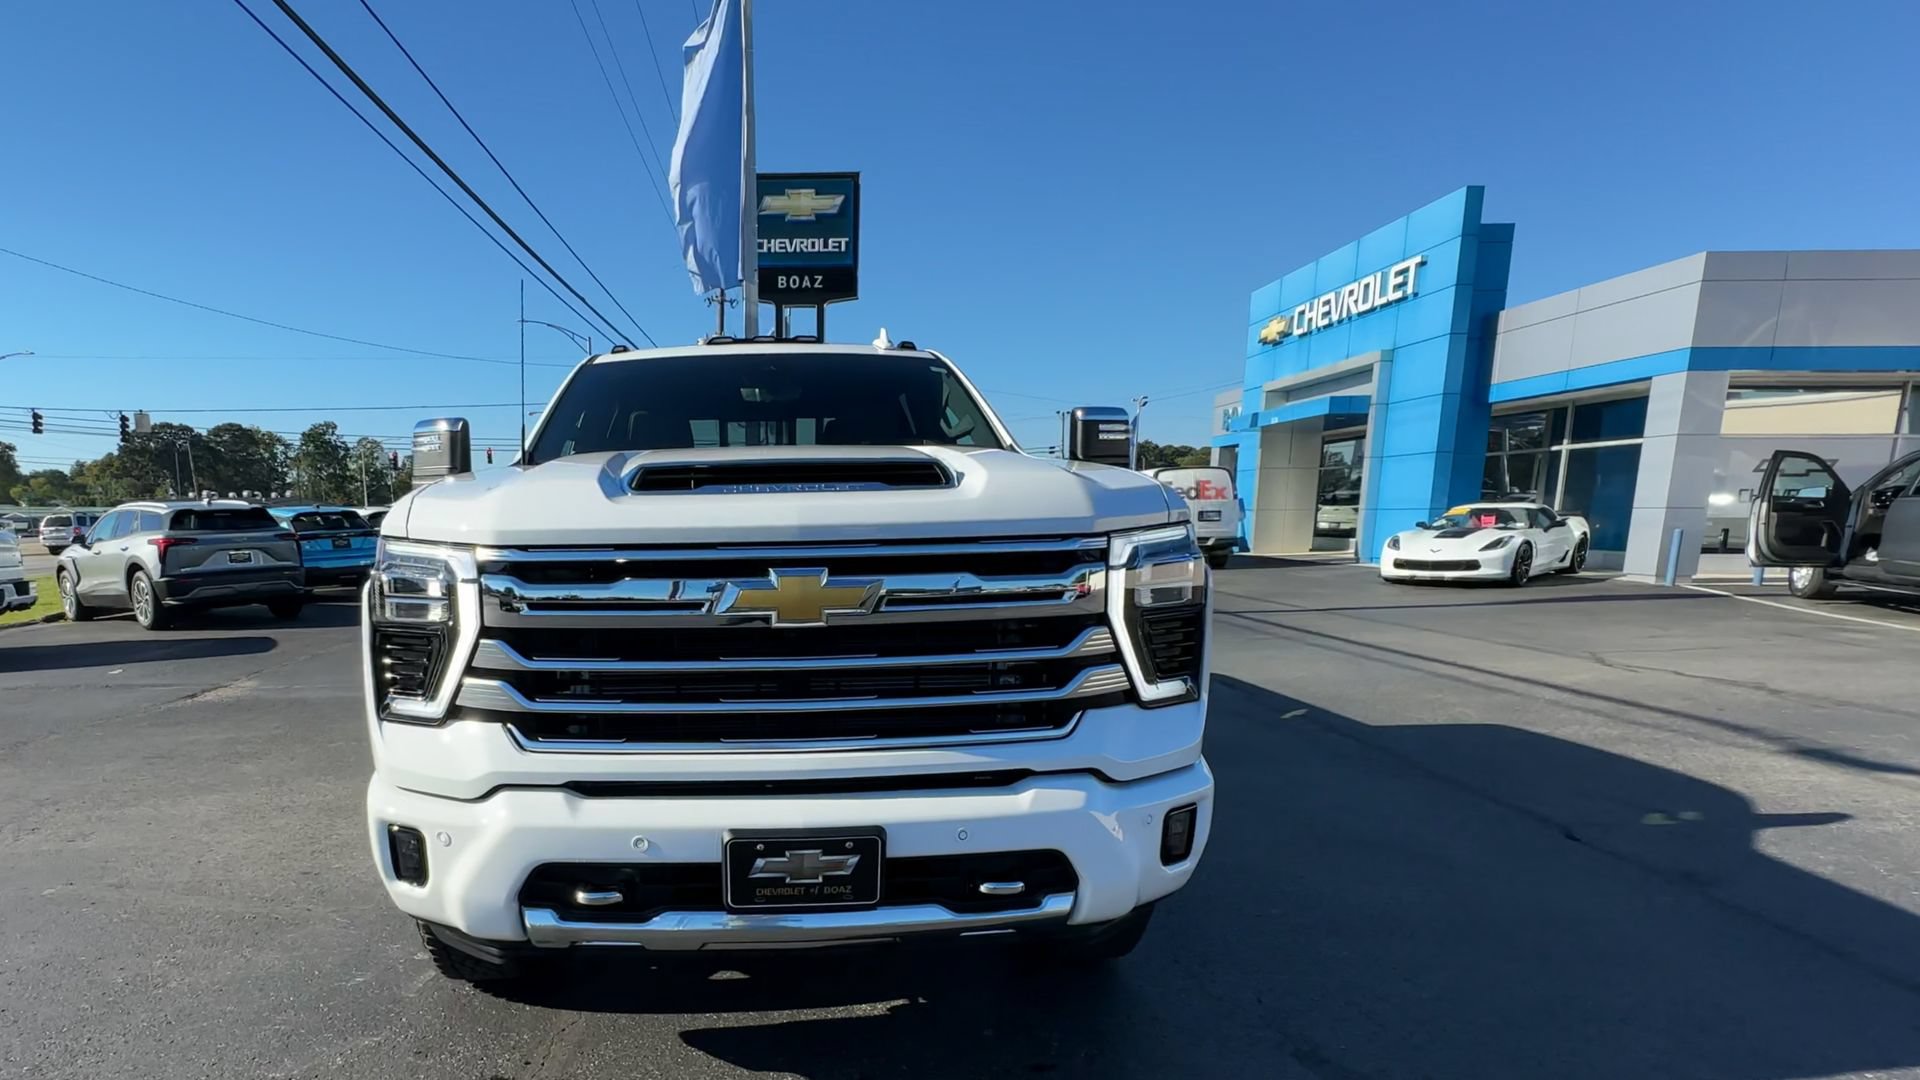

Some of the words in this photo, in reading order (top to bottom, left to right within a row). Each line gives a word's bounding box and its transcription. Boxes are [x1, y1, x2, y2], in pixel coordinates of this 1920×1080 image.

[777, 275, 824, 289] BOAZ
[1292, 254, 1424, 336] CHEVROLET
[1164, 480, 1228, 500] edEx
[755, 887, 806, 896] CHEVROLET
[823, 885, 853, 895] BOAZ
